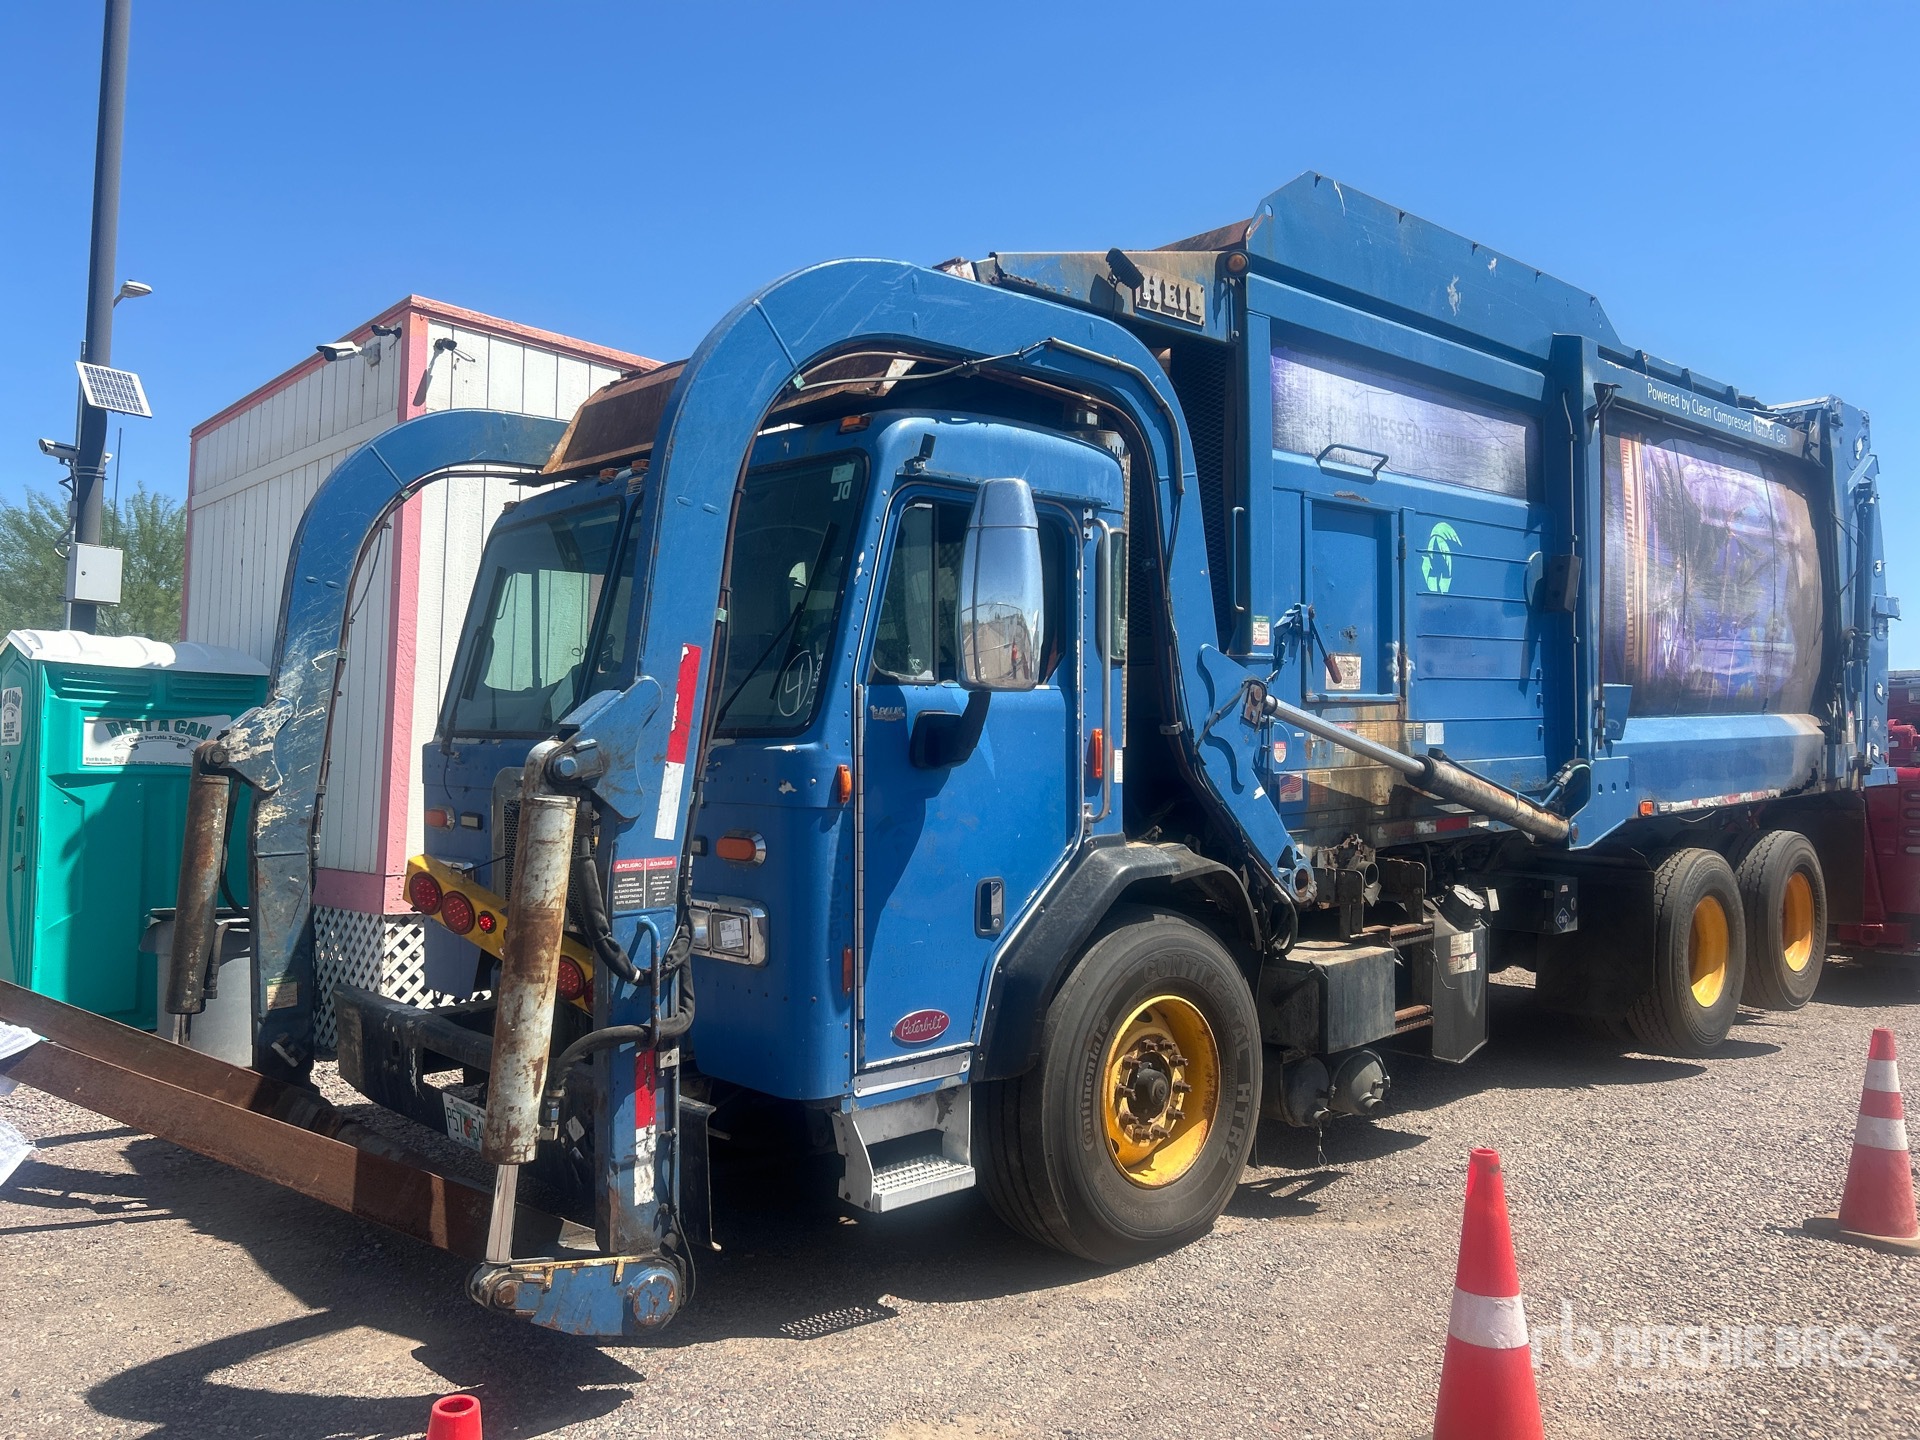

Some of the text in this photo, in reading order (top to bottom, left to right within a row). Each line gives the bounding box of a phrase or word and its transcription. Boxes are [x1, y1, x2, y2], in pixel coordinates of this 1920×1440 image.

[1141, 273, 1202, 319] HEIL
[1647, 382, 1787, 445] Powered by Clean Compressed Natural Gas
[785, 663, 805, 709] 4
[105, 720, 213, 740] RENT A CAN
[168, 735, 186, 743] Toilets
[1558, 915, 1568, 924] CNG
[901, 1015, 945, 1038] Peterbilt
[1143, 953, 1250, 1059] CONTINENTAL
[1080, 1030, 1105, 1152] Continental
[1221, 1083, 1251, 1166] HTR2
